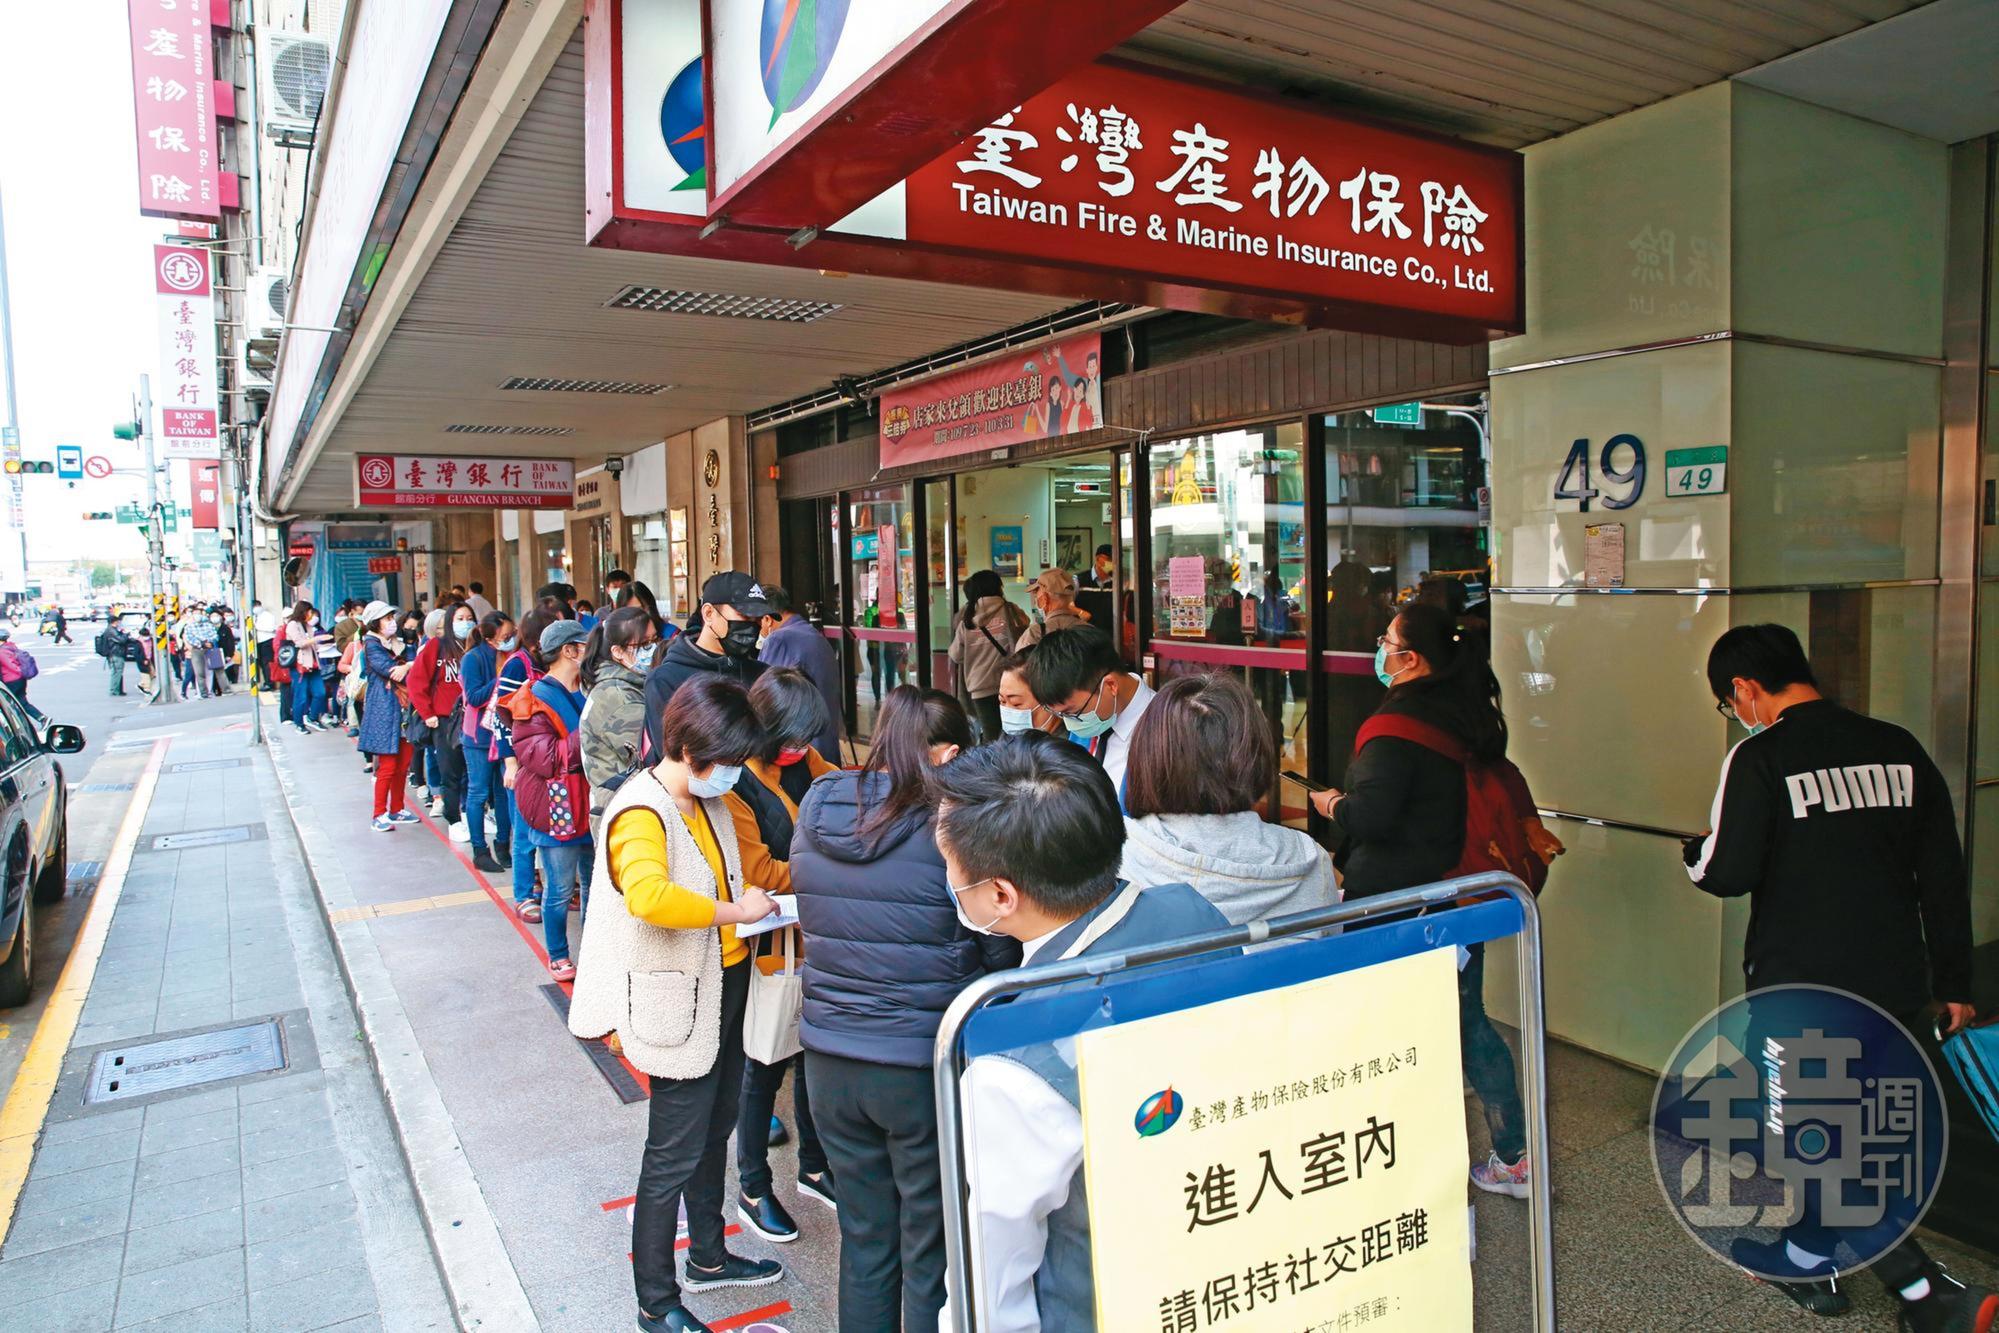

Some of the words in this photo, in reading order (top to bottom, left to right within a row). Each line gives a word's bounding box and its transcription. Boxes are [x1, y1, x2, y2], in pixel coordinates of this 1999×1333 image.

[192, 33, 204, 75] Marine
[195, 81, 207, 143] Insurance
[199, 148, 210, 174] Co.,
[200, 179, 212, 205] Ltd.
[951, 181, 1070, 228] Taiwan
[1076, 201, 1139, 238] Fire
[1145, 213, 1168, 241] &
[1176, 216, 1269, 257] Marine
[1276, 239, 1396, 279] Insurance
[1401, 257, 1448, 291] Co.,
[1452, 262, 1496, 295] Ltd.
[173, 300, 201, 405] 臺灣銀行
[174, 412, 205, 420] BANK
[912, 393, 972, 429] 店家來兌領
[168, 427, 212, 436] TAIWAN
[404, 459, 523, 489] 臺灣銀行
[532, 461, 559, 472] BANK
[532, 471, 544, 481] OF
[1553, 432, 1647, 513] 49
[1678, 467, 1713, 491] 49
[447, 494, 500, 505] GUANCIAN
[501, 494, 542, 506] BRANCH
[532, 480, 570, 491] TAIWAN
[1784, 763, 1915, 819] PUMA
[1187, 1046, 1419, 1133] 臺灣產物保險股份有限公司
[1183, 1115, 1397, 1234] 進入室內
[1158, 1207, 1429, 1333] 請保持社交距離
